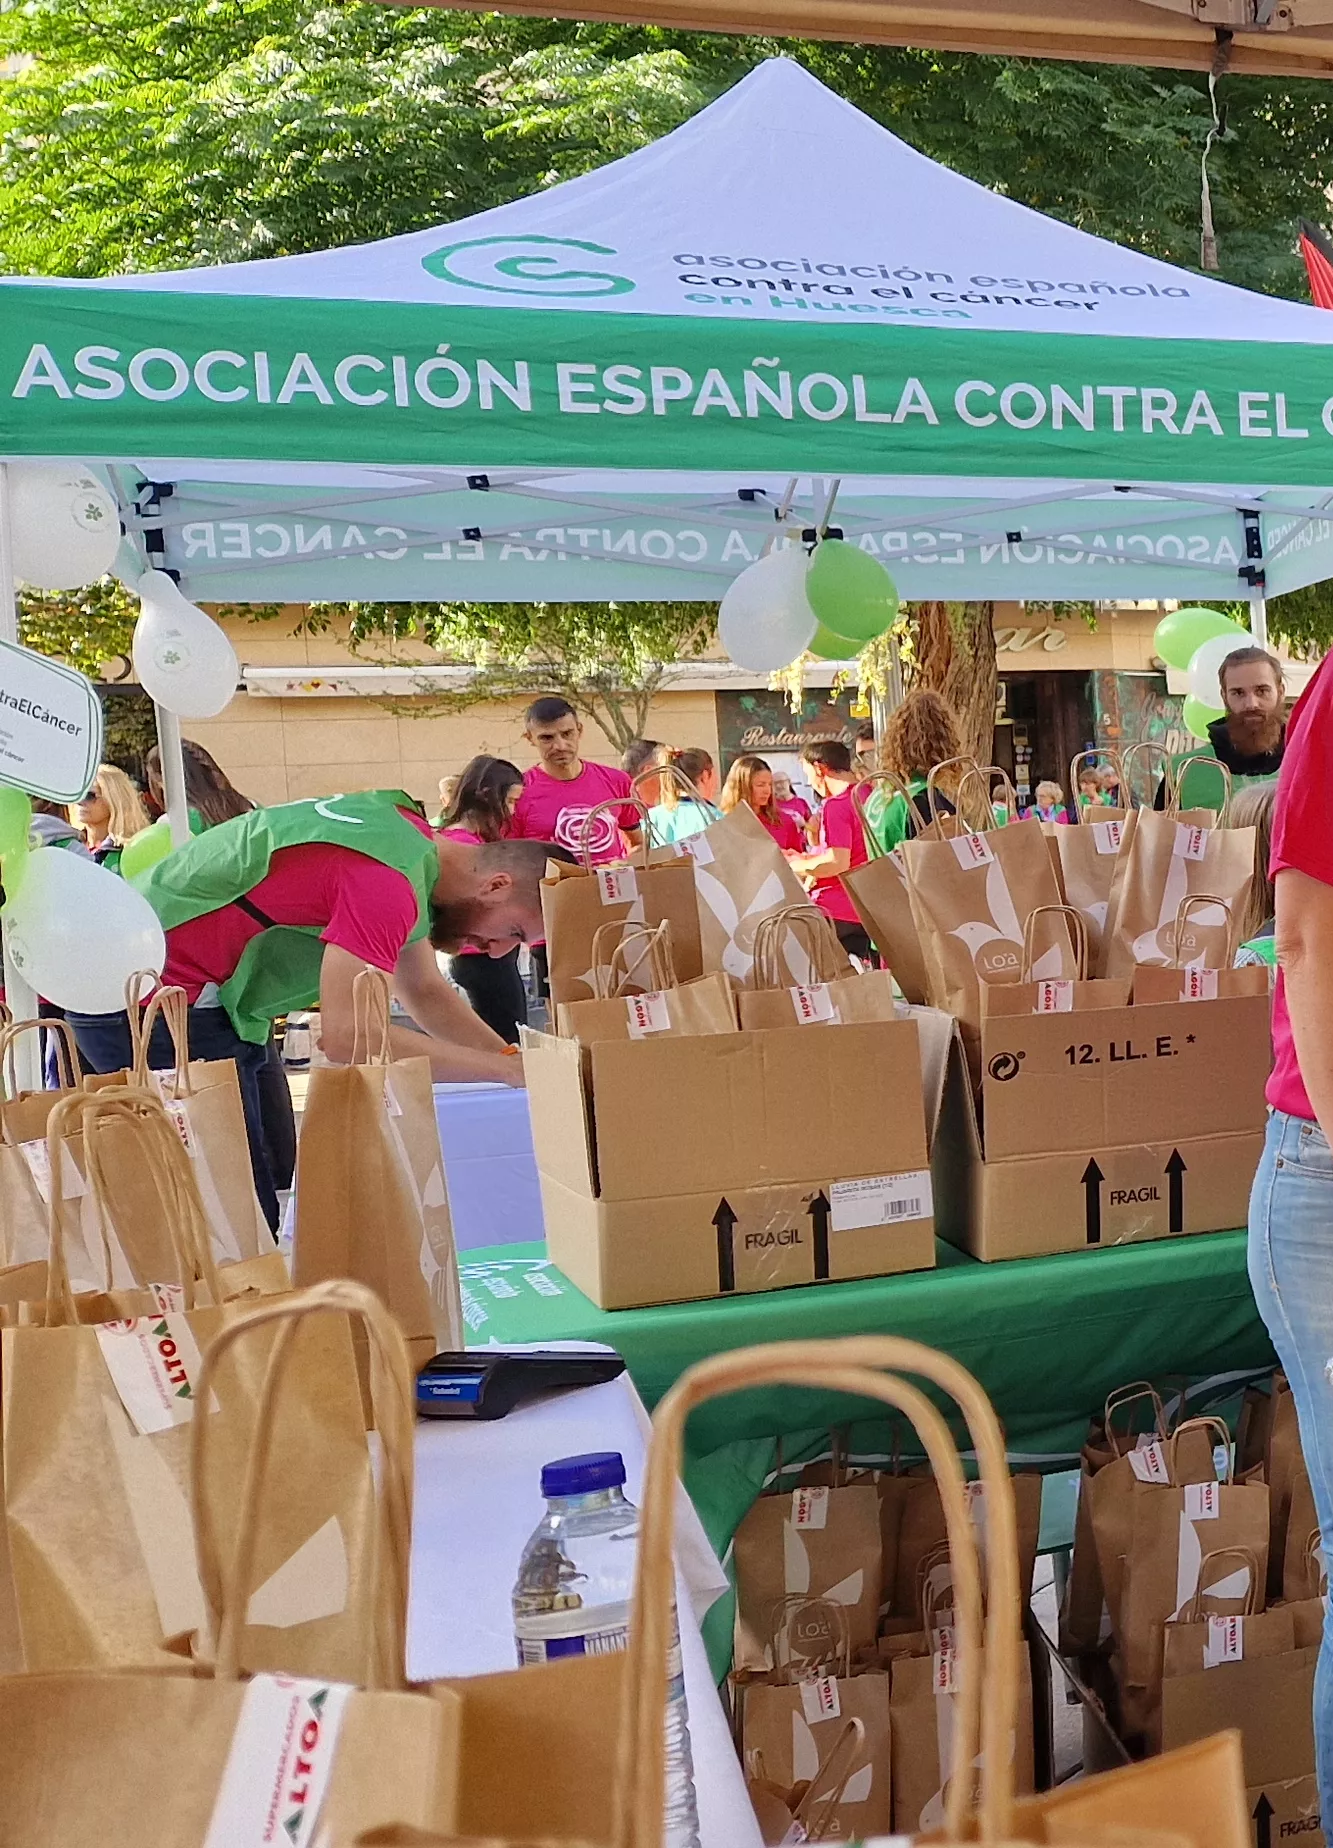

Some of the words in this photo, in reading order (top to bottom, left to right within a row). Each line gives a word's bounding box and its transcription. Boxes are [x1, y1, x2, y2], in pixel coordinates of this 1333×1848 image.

[672, 252, 953, 286] asociación
[968, 271, 1192, 298] española
[677, 272, 855, 297] contra
[870, 282, 914, 299] el
[928, 288, 1101, 312] cáncer
[683, 291, 752, 307] en
[771, 294, 973, 319] Huesca
[12, 343, 531, 413] ASOCIACIÓN
[557, 355, 940, 425] ESPAÑOLA
[954, 380, 1224, 436] CONTRA
[1238, 391, 1309, 438] EL
[994, 626, 1068, 652] ar
[740, 724, 853, 747] Restaurante
[1064, 1044, 1100, 1065] 12.
[1109, 1040, 1147, 1062] LL.
[1156, 1037, 1179, 1058] E.
[1109, 1187, 1160, 1206] FRAGIL
[744, 1228, 803, 1251] FRAGIL
[1280, 1813, 1321, 1839] FRAG
